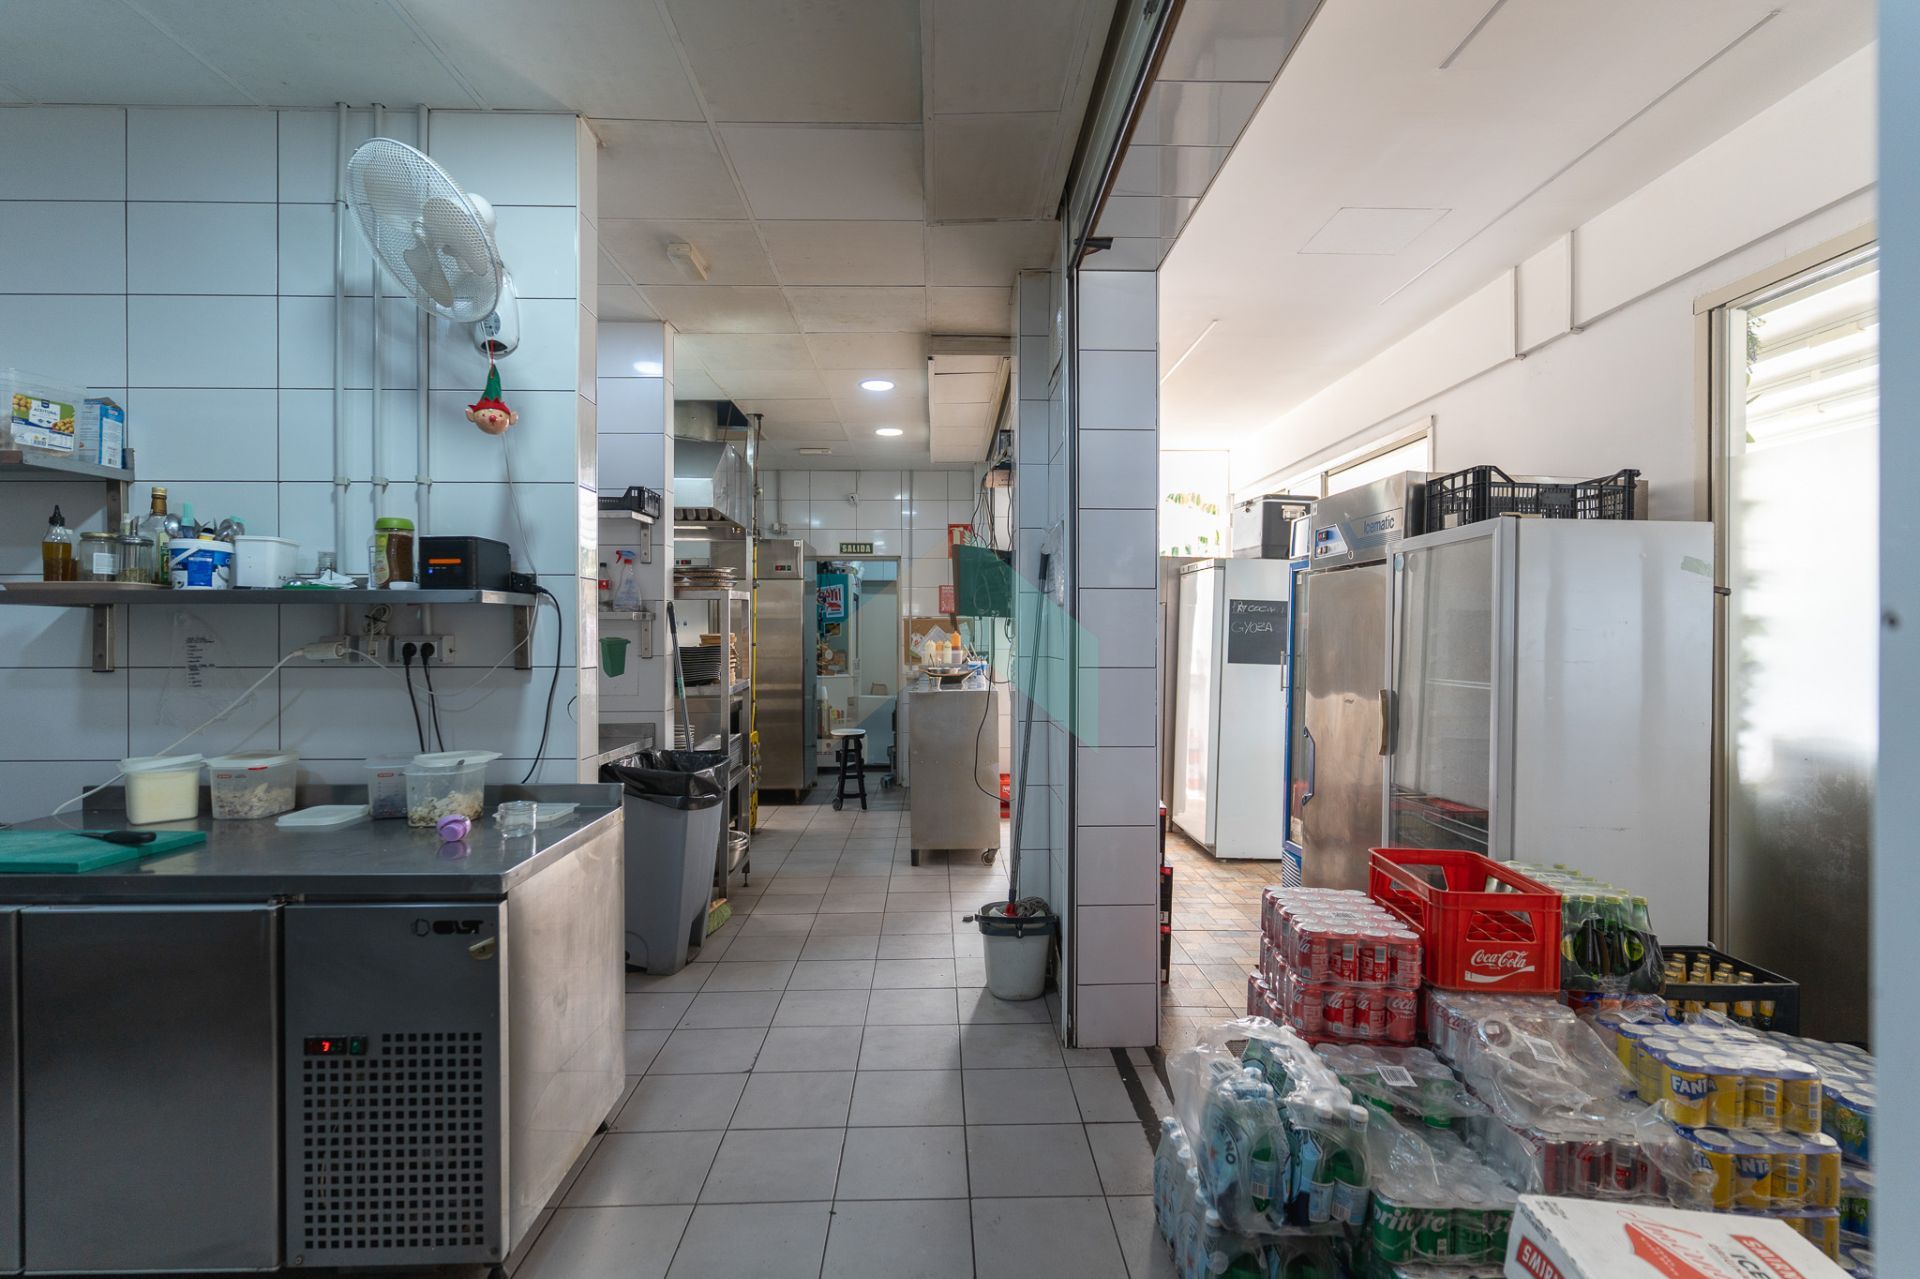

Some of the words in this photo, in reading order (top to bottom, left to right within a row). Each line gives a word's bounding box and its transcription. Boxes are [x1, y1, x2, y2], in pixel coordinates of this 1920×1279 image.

[1363, 515, 1395, 534] Icematic
[842, 544, 871, 553] SALIDA
[1231, 621, 1273, 634] GYOZA
[1471, 949, 1528, 969] Coca-Cola
[1672, 1075, 1716, 1095] FANTA
